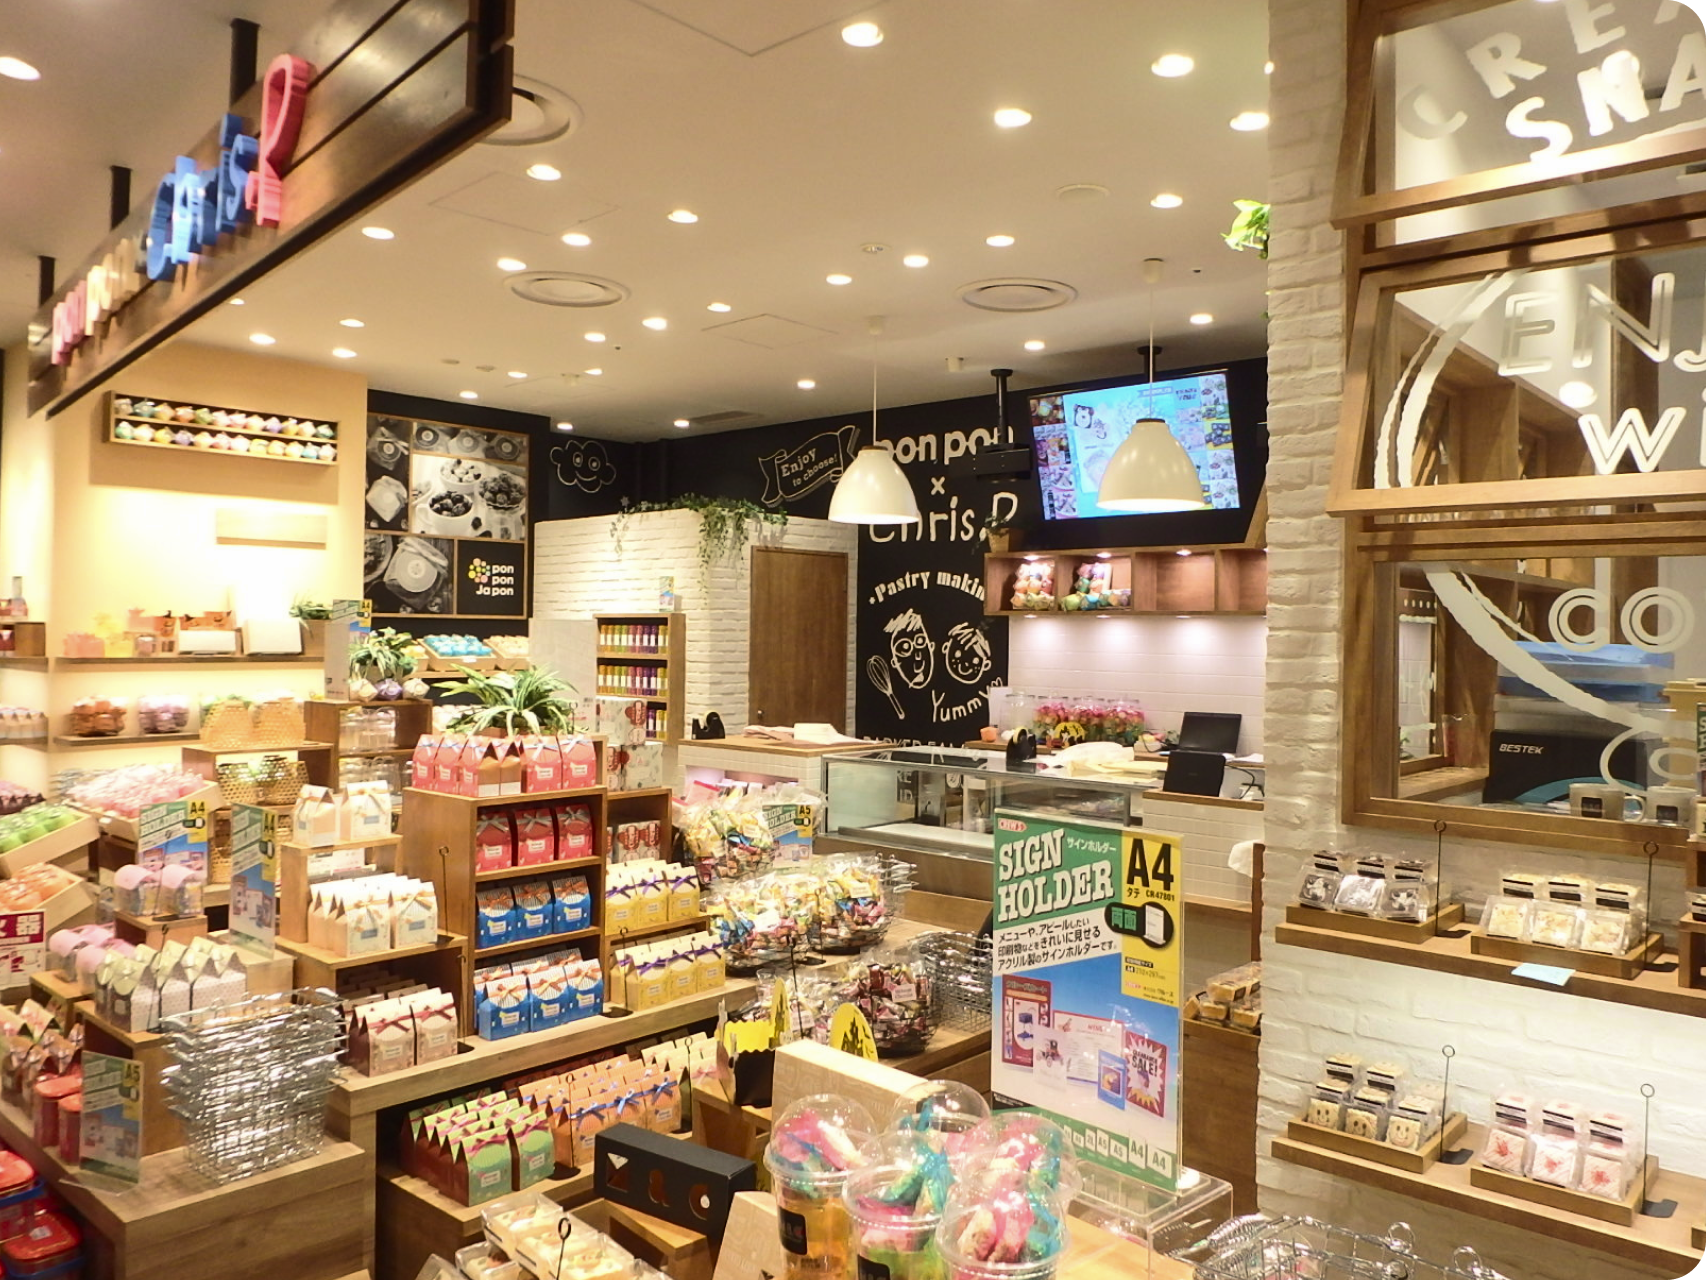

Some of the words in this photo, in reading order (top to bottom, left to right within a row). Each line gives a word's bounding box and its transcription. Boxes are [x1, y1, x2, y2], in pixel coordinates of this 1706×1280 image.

[781, 448, 817, 478] Enjoy
[792, 477, 802, 487] to
[803, 453, 838, 481] choose!
[492, 565, 515, 575] pon
[492, 576, 515, 586] pon
[874, 571, 931, 603] Pastry
[1499, 743, 1544, 755] BESTEK
[190, 801, 205, 815] A4
[800, 805, 811, 815] A5
[999, 828, 1065, 882] SIGN
[1066, 837, 1117, 854] サインホルダー
[1126, 838, 1175, 891] A4
[998, 859, 1115, 922] HOLDER
[1127, 887, 1140, 899] タテ
[1130, 1140, 1144, 1159] A4
[1152, 1151, 1166, 1171] A4
